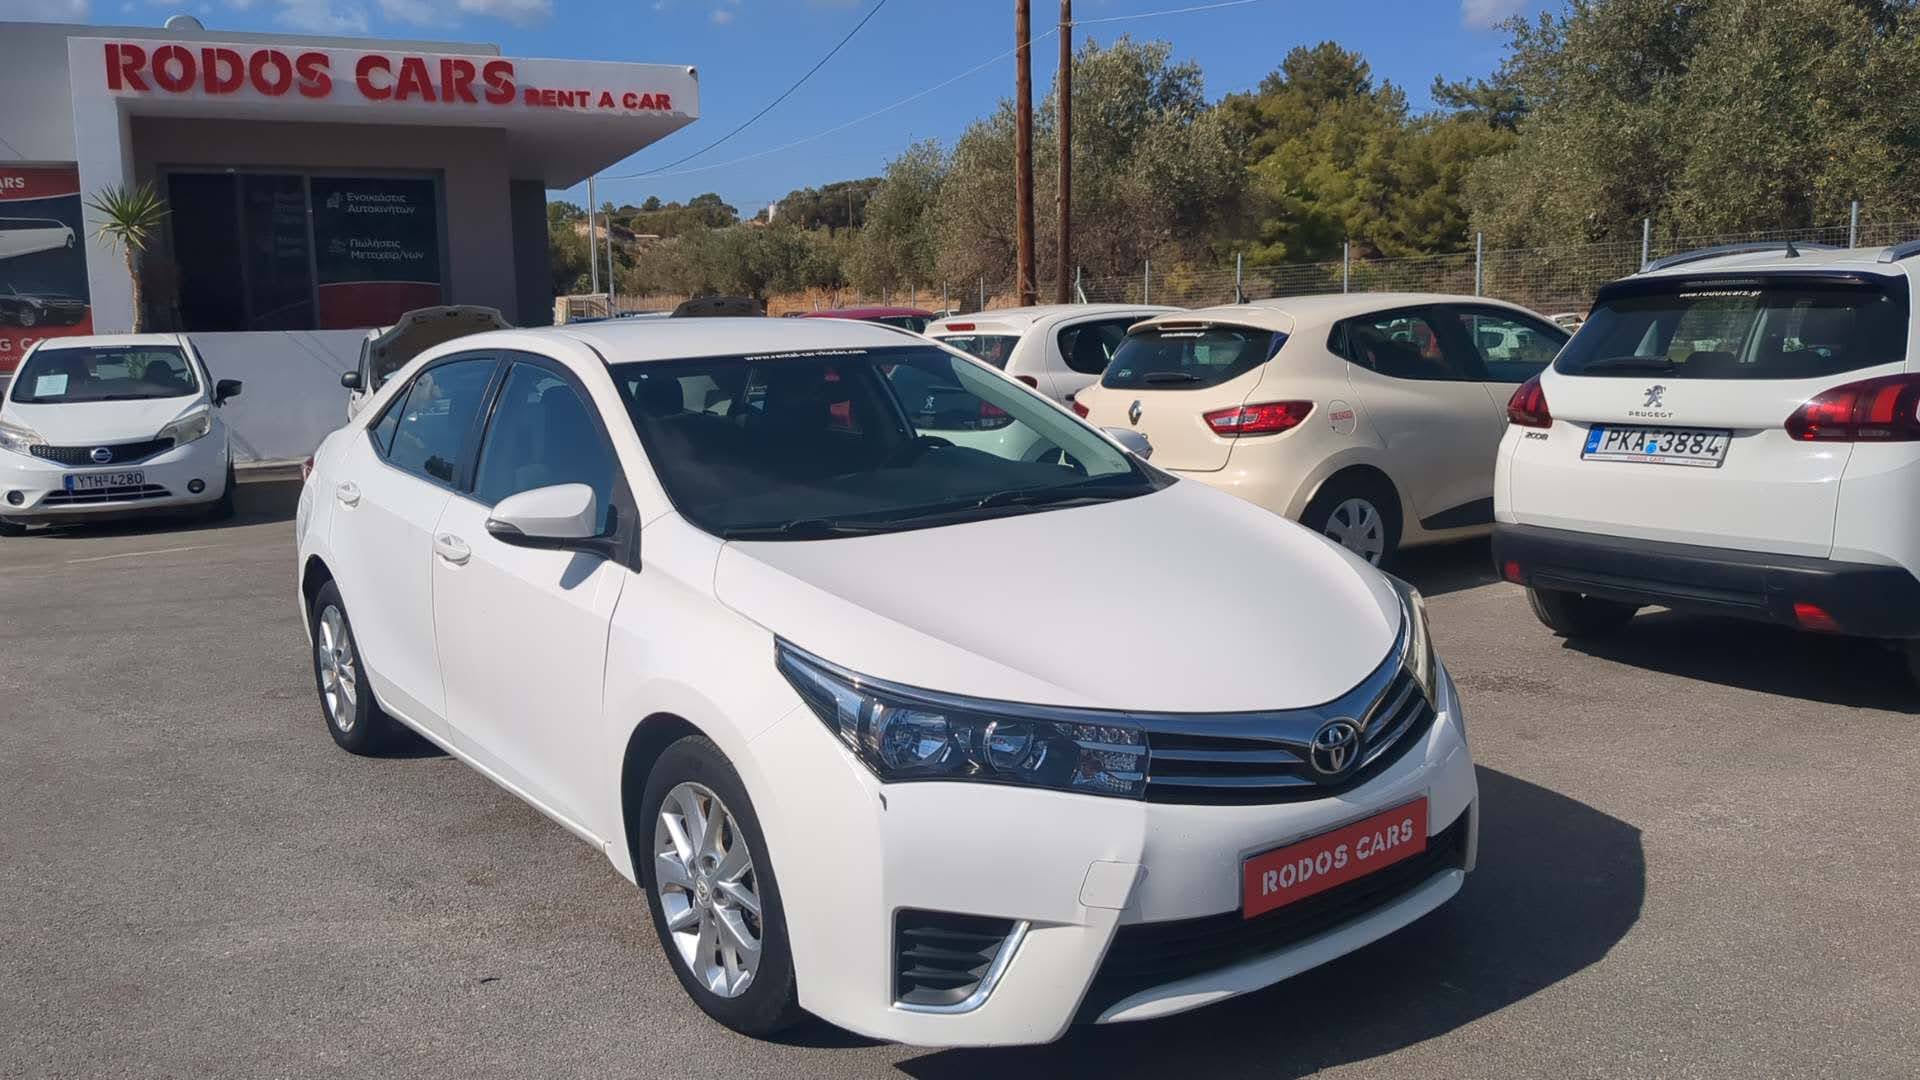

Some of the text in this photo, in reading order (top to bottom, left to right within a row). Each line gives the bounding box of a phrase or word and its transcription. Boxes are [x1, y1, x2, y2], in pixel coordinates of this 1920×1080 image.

[104, 43, 516, 105] RODOS CARS
[525, 88, 673, 110] RENT A CAR
[350, 239, 401, 249] Πωλήσεις
[1628, 410, 1674, 418] PEUGEOT
[1262, 818, 1413, 896] RODOS CARS
